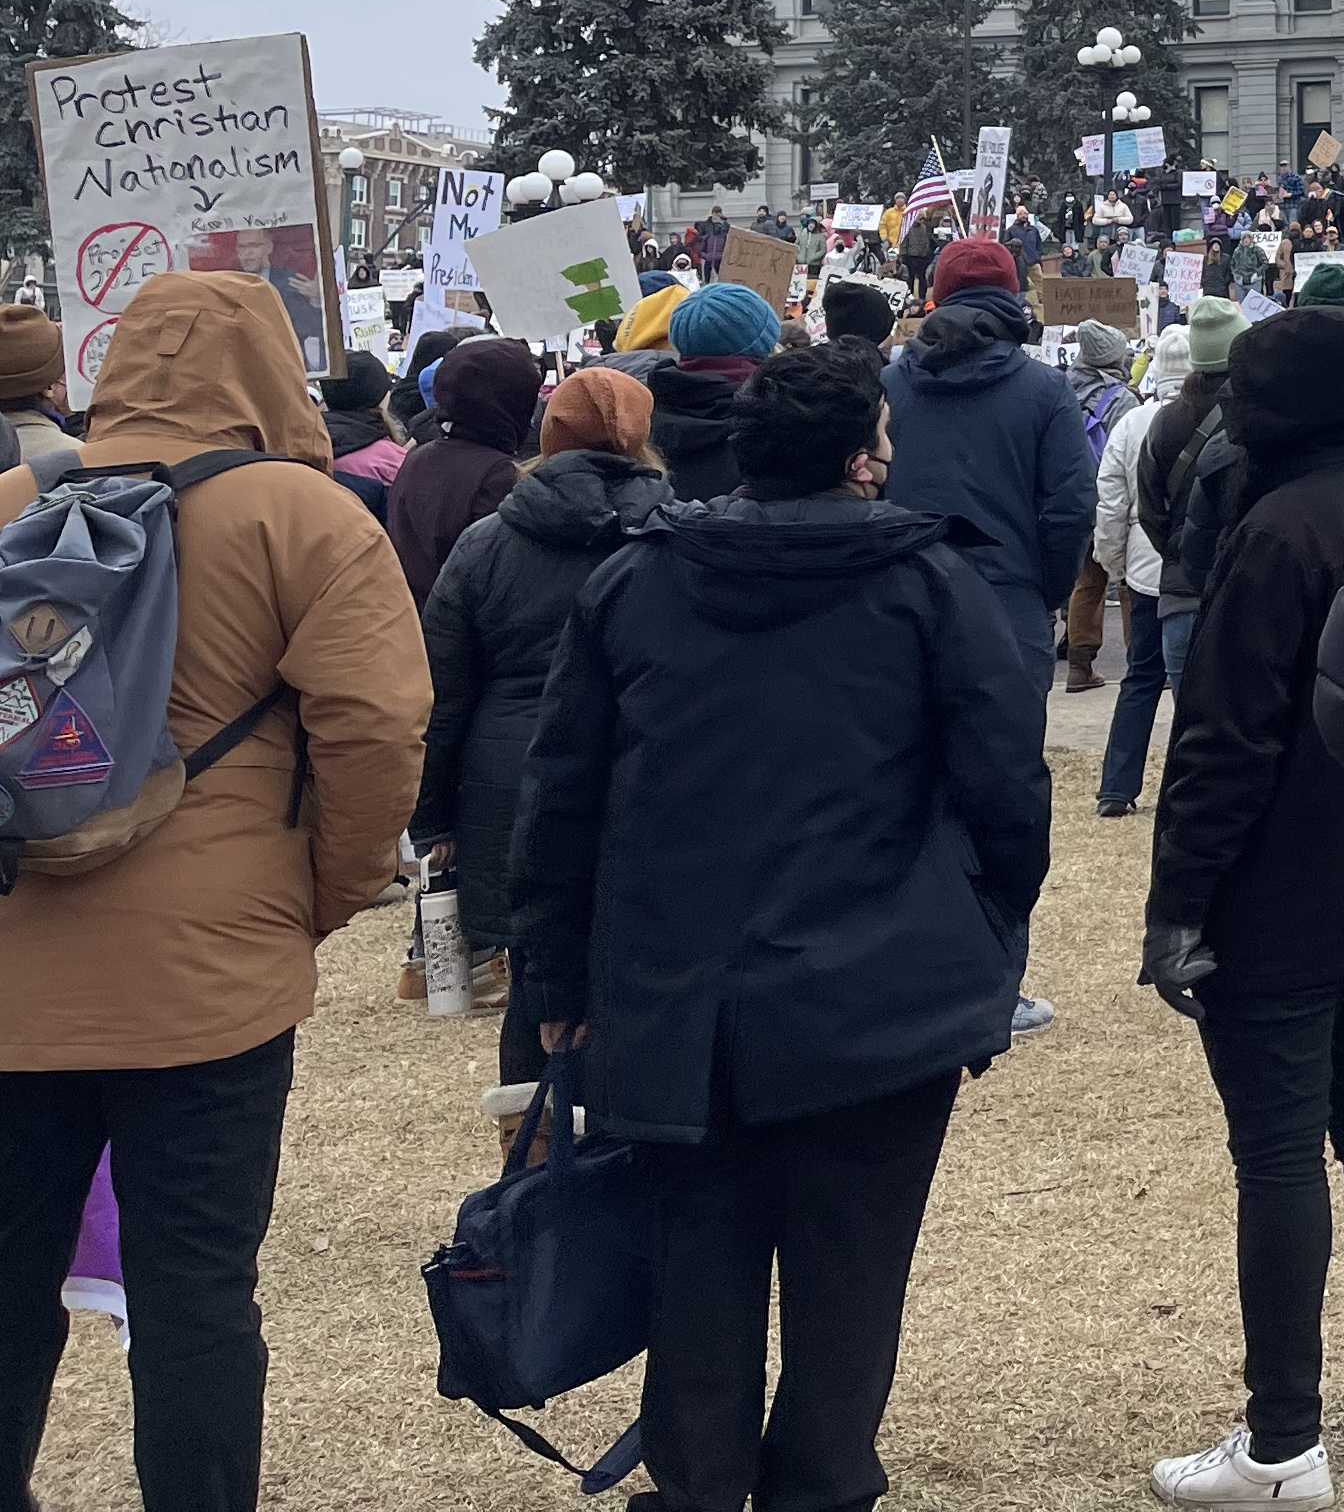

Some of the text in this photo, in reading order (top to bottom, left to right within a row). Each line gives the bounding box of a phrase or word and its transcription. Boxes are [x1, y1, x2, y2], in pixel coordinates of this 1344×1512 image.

[50, 64, 222, 120] Protest
[74, 145, 300, 201] Nationalism
[441, 171, 494, 211] Not
[88, 238, 164, 266] Project
[1252, 232, 1279, 243] PEACH
[1167, 255, 1180, 267] NO
[1180, 268, 1202, 281] KKK
[88, 262, 157, 292] 2025
